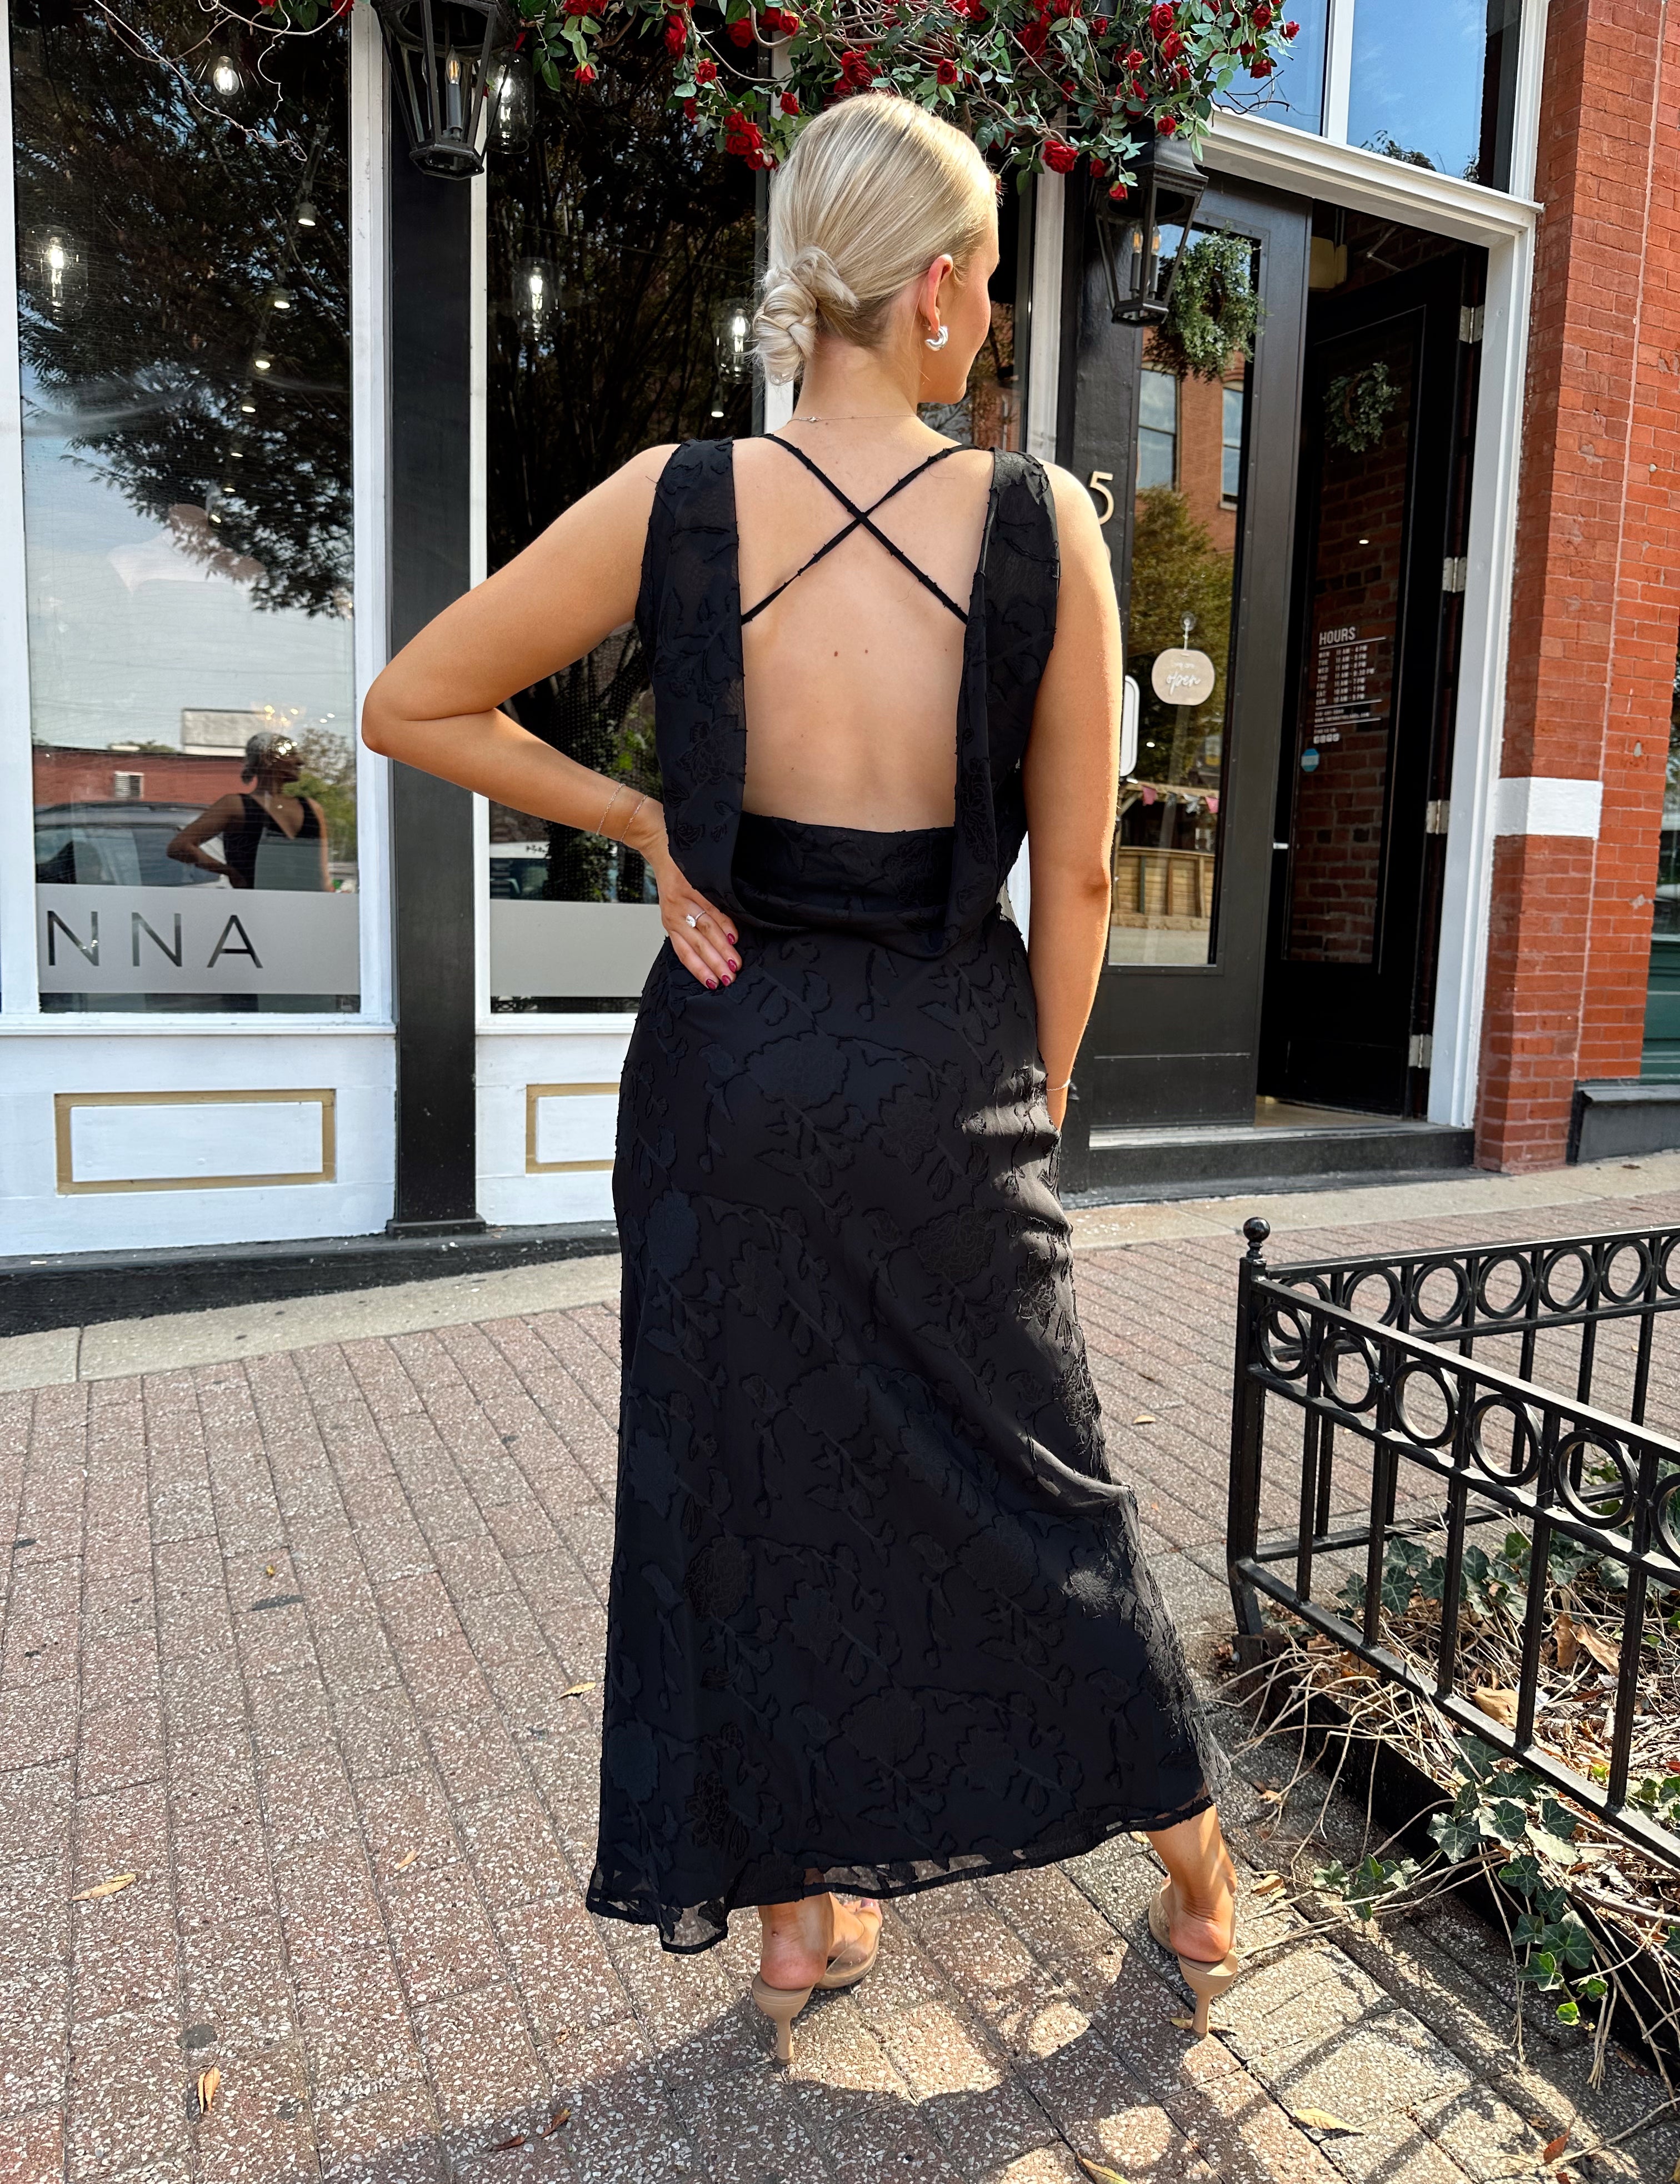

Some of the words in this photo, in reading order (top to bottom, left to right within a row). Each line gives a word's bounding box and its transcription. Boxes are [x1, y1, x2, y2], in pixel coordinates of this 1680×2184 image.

[1089, 471, 1114, 524] 5
[1319, 626, 1356, 646] HOURS
[1167, 671, 1201, 695] open
[47, 911, 263, 968] NNA
